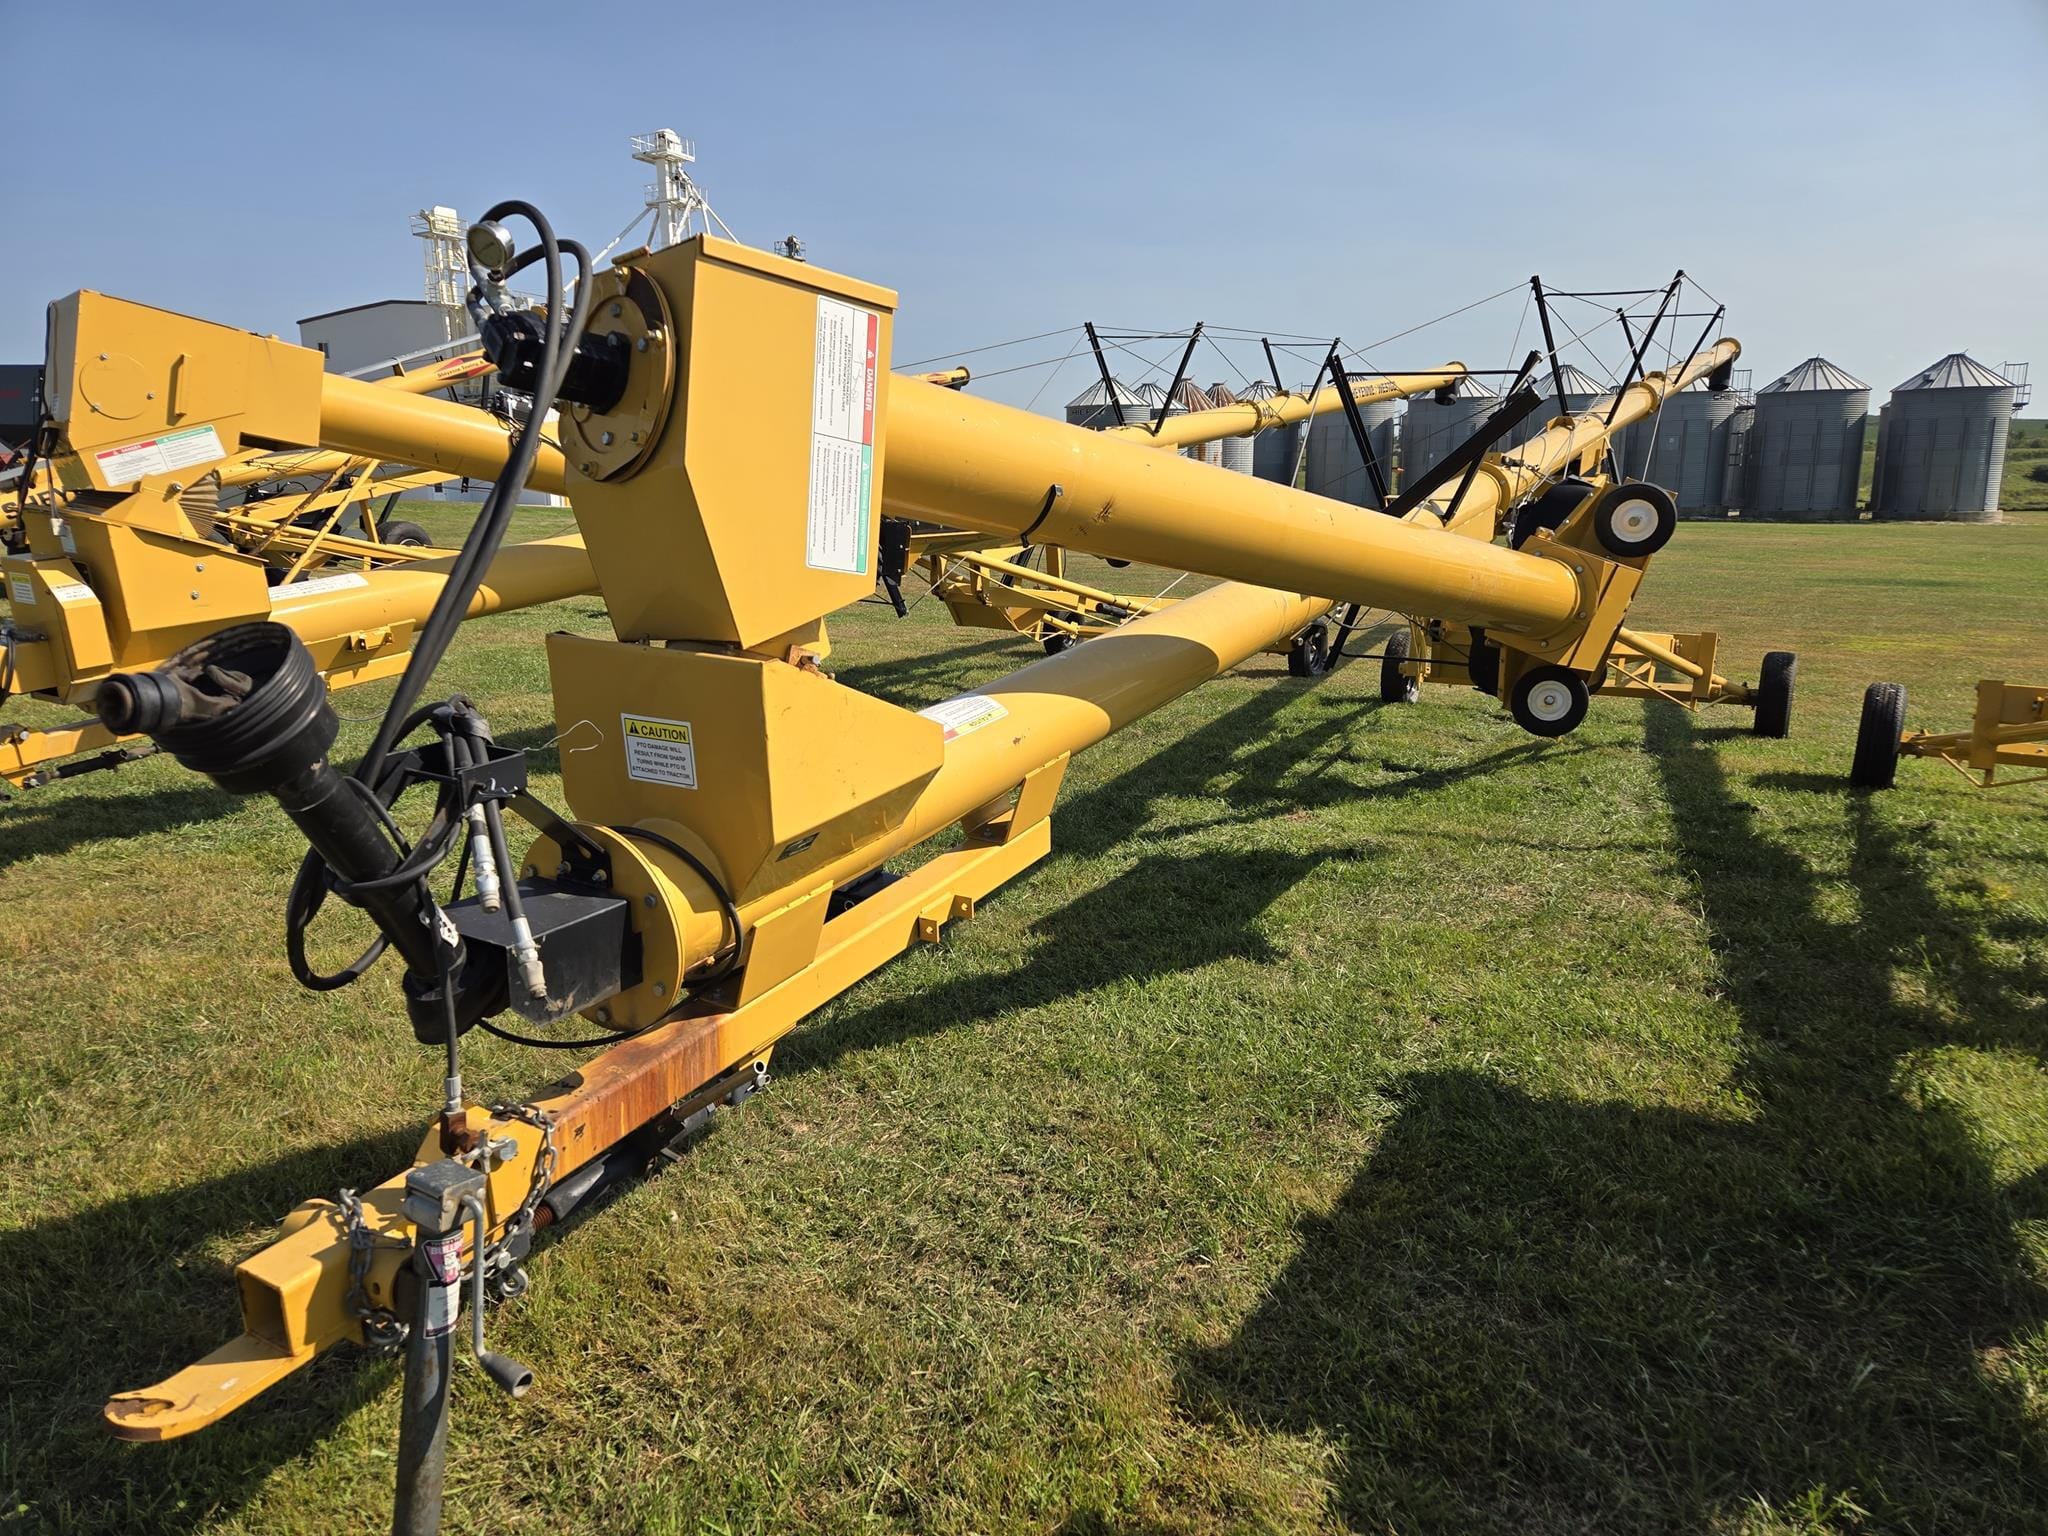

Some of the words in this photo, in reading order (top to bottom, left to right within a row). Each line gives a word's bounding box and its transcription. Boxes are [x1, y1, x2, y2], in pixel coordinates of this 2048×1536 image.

[865, 368, 874, 411] DANGER
[640, 725, 687, 741] CAUTION
[647, 743, 668, 751] DAMAGE
[654, 752, 668, 760] FROM
[668, 754, 686, 762] SHARP
[636, 758, 653, 766] TURNS
[654, 760, 669, 768] WHILE
[669, 762, 680, 770] PTO
[632, 766, 658, 775] ATTACHED
